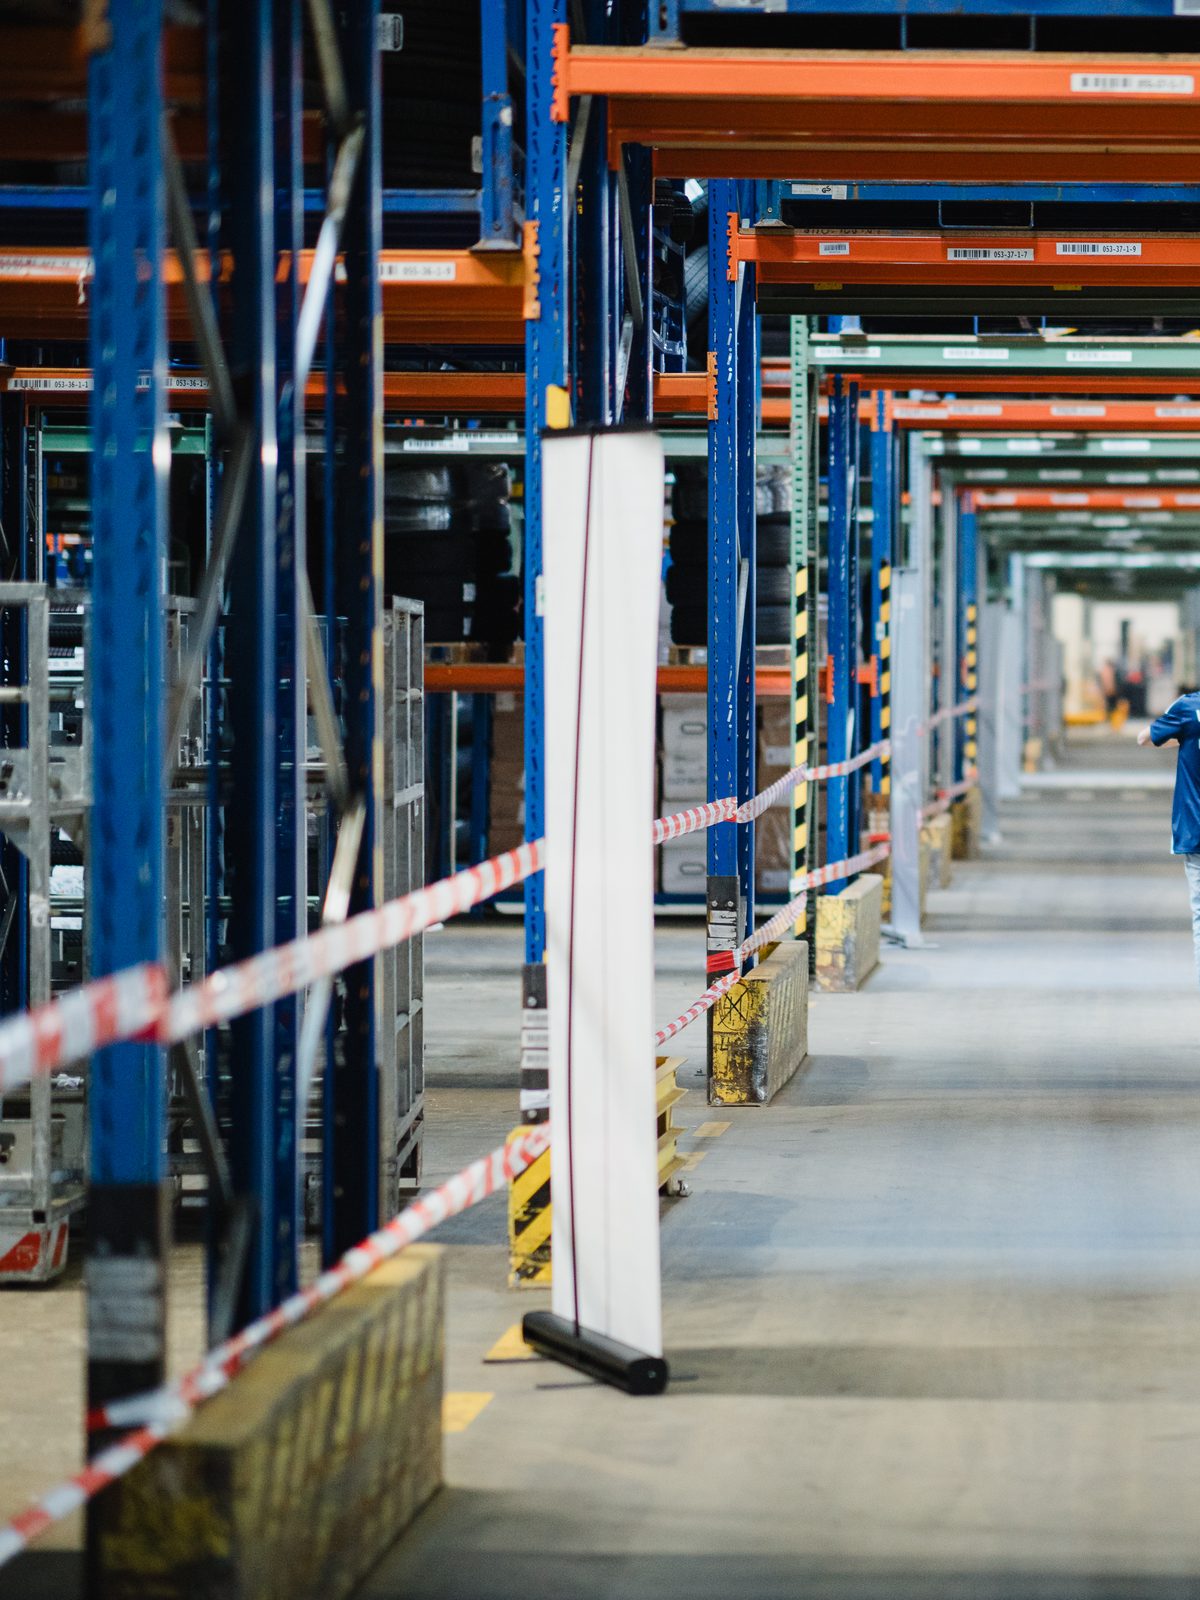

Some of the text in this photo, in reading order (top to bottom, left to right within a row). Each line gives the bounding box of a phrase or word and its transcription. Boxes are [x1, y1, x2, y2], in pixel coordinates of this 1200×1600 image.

[1102, 245, 1137, 253] 053-37-1-9
[993, 250, 1028, 259] 053-37-1-7
[54, 380, 89, 389] 053-36-1-1
